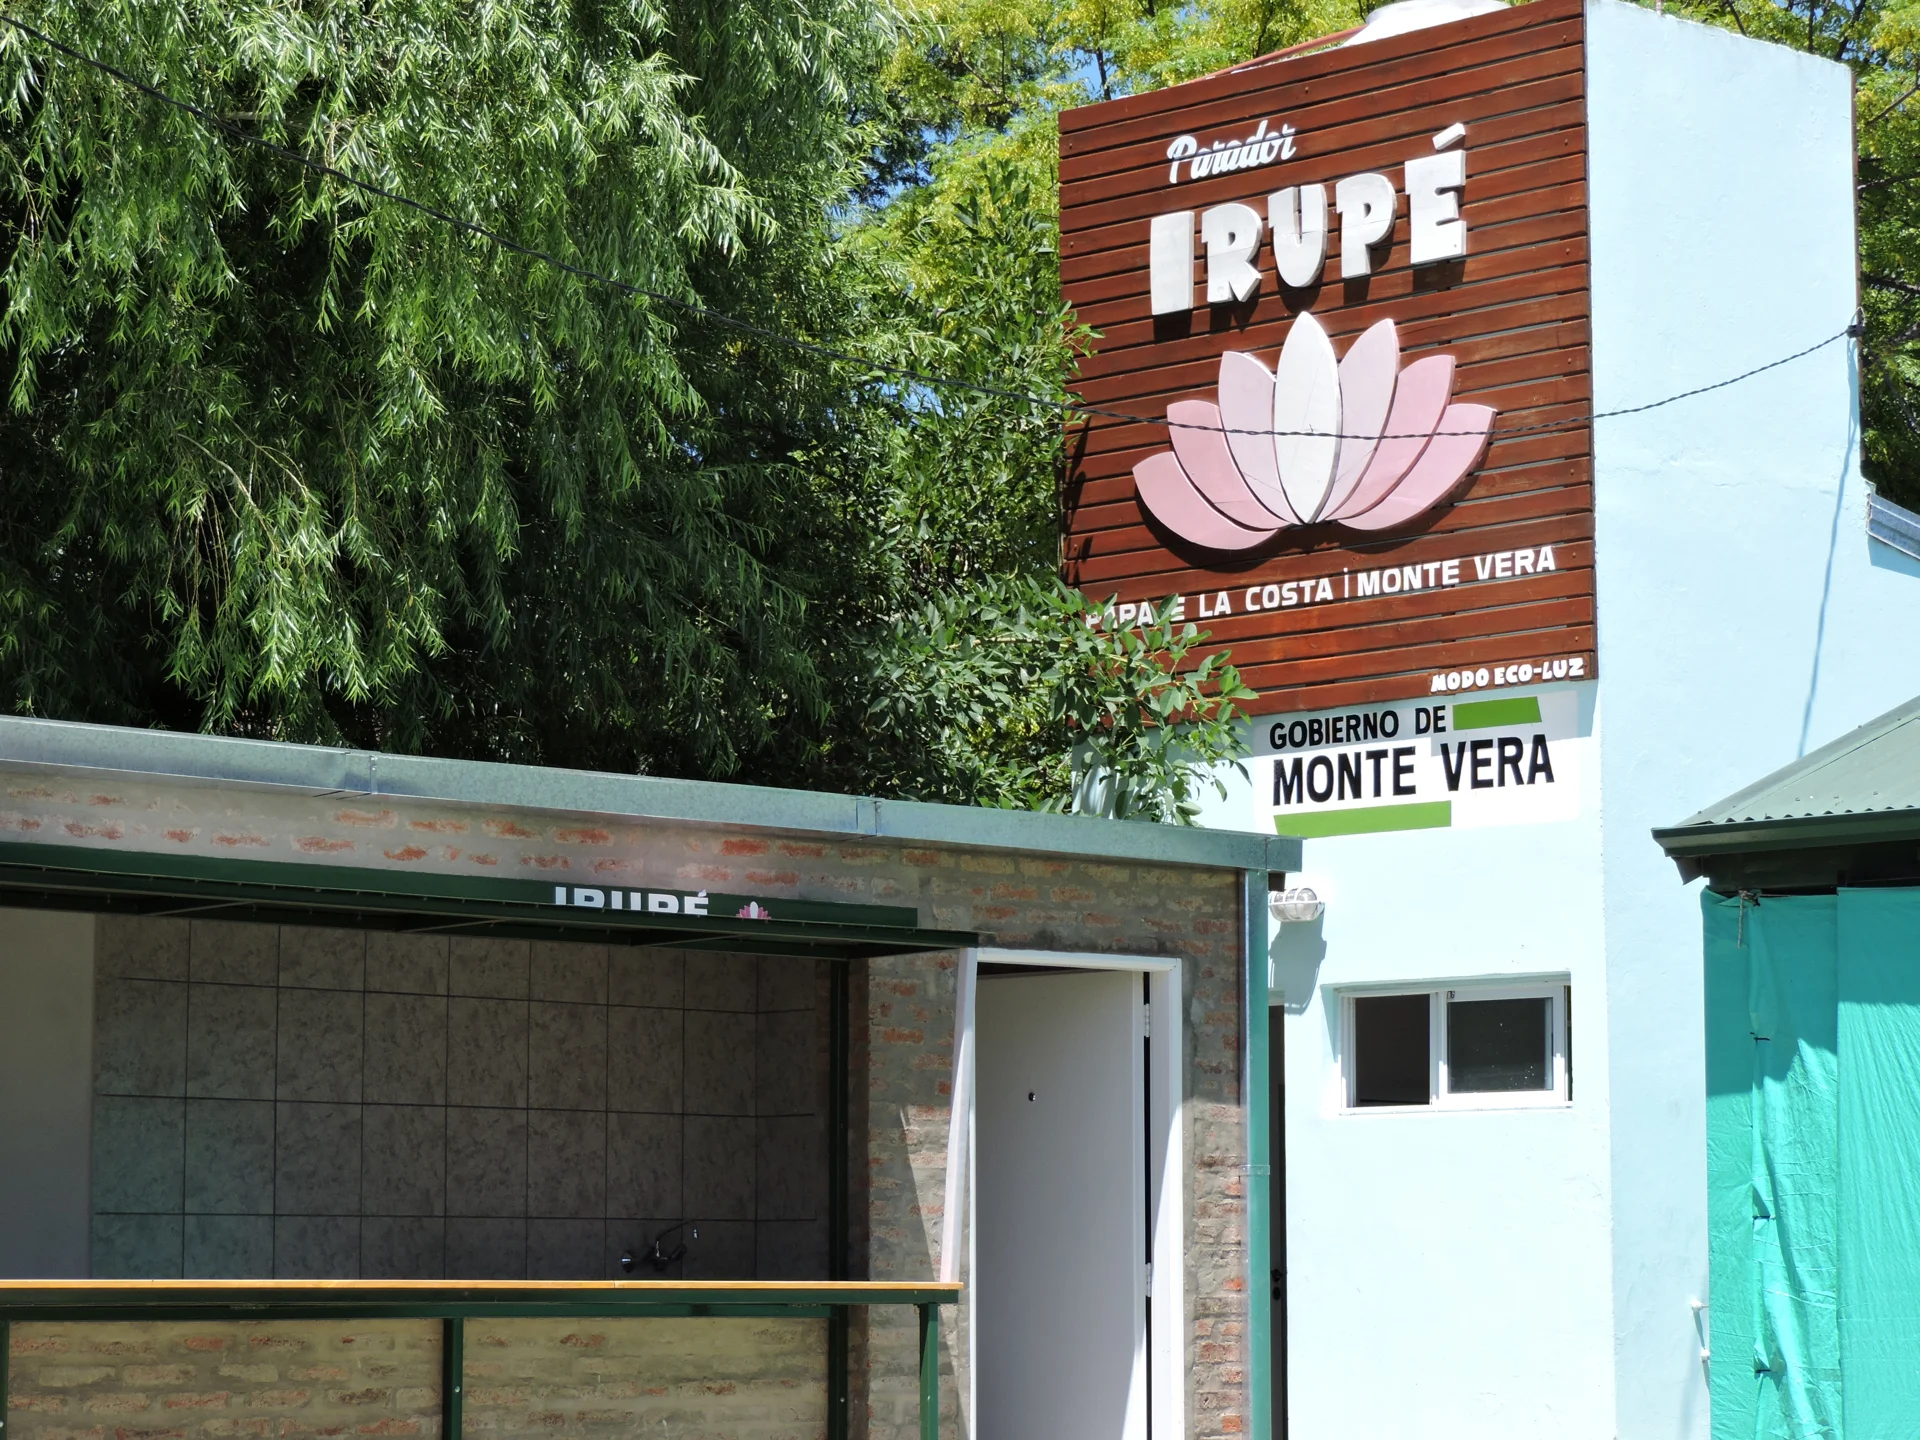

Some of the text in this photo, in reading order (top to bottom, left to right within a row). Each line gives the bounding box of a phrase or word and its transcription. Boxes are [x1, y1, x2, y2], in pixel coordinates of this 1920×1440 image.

[1167, 119, 1297, 183] Parador
[1149, 122, 1467, 316] IRUPÉ
[1199, 591, 1232, 618] LA
[1245, 577, 1334, 612] COSTA
[1357, 559, 1460, 597] MONTE
[1474, 545, 1556, 580] VERA
[1429, 657, 1584, 693] MODO ECO-LUZ
[1269, 705, 1447, 750] GOBIERNO DE
[1272, 733, 1555, 806] MONTE VERA
